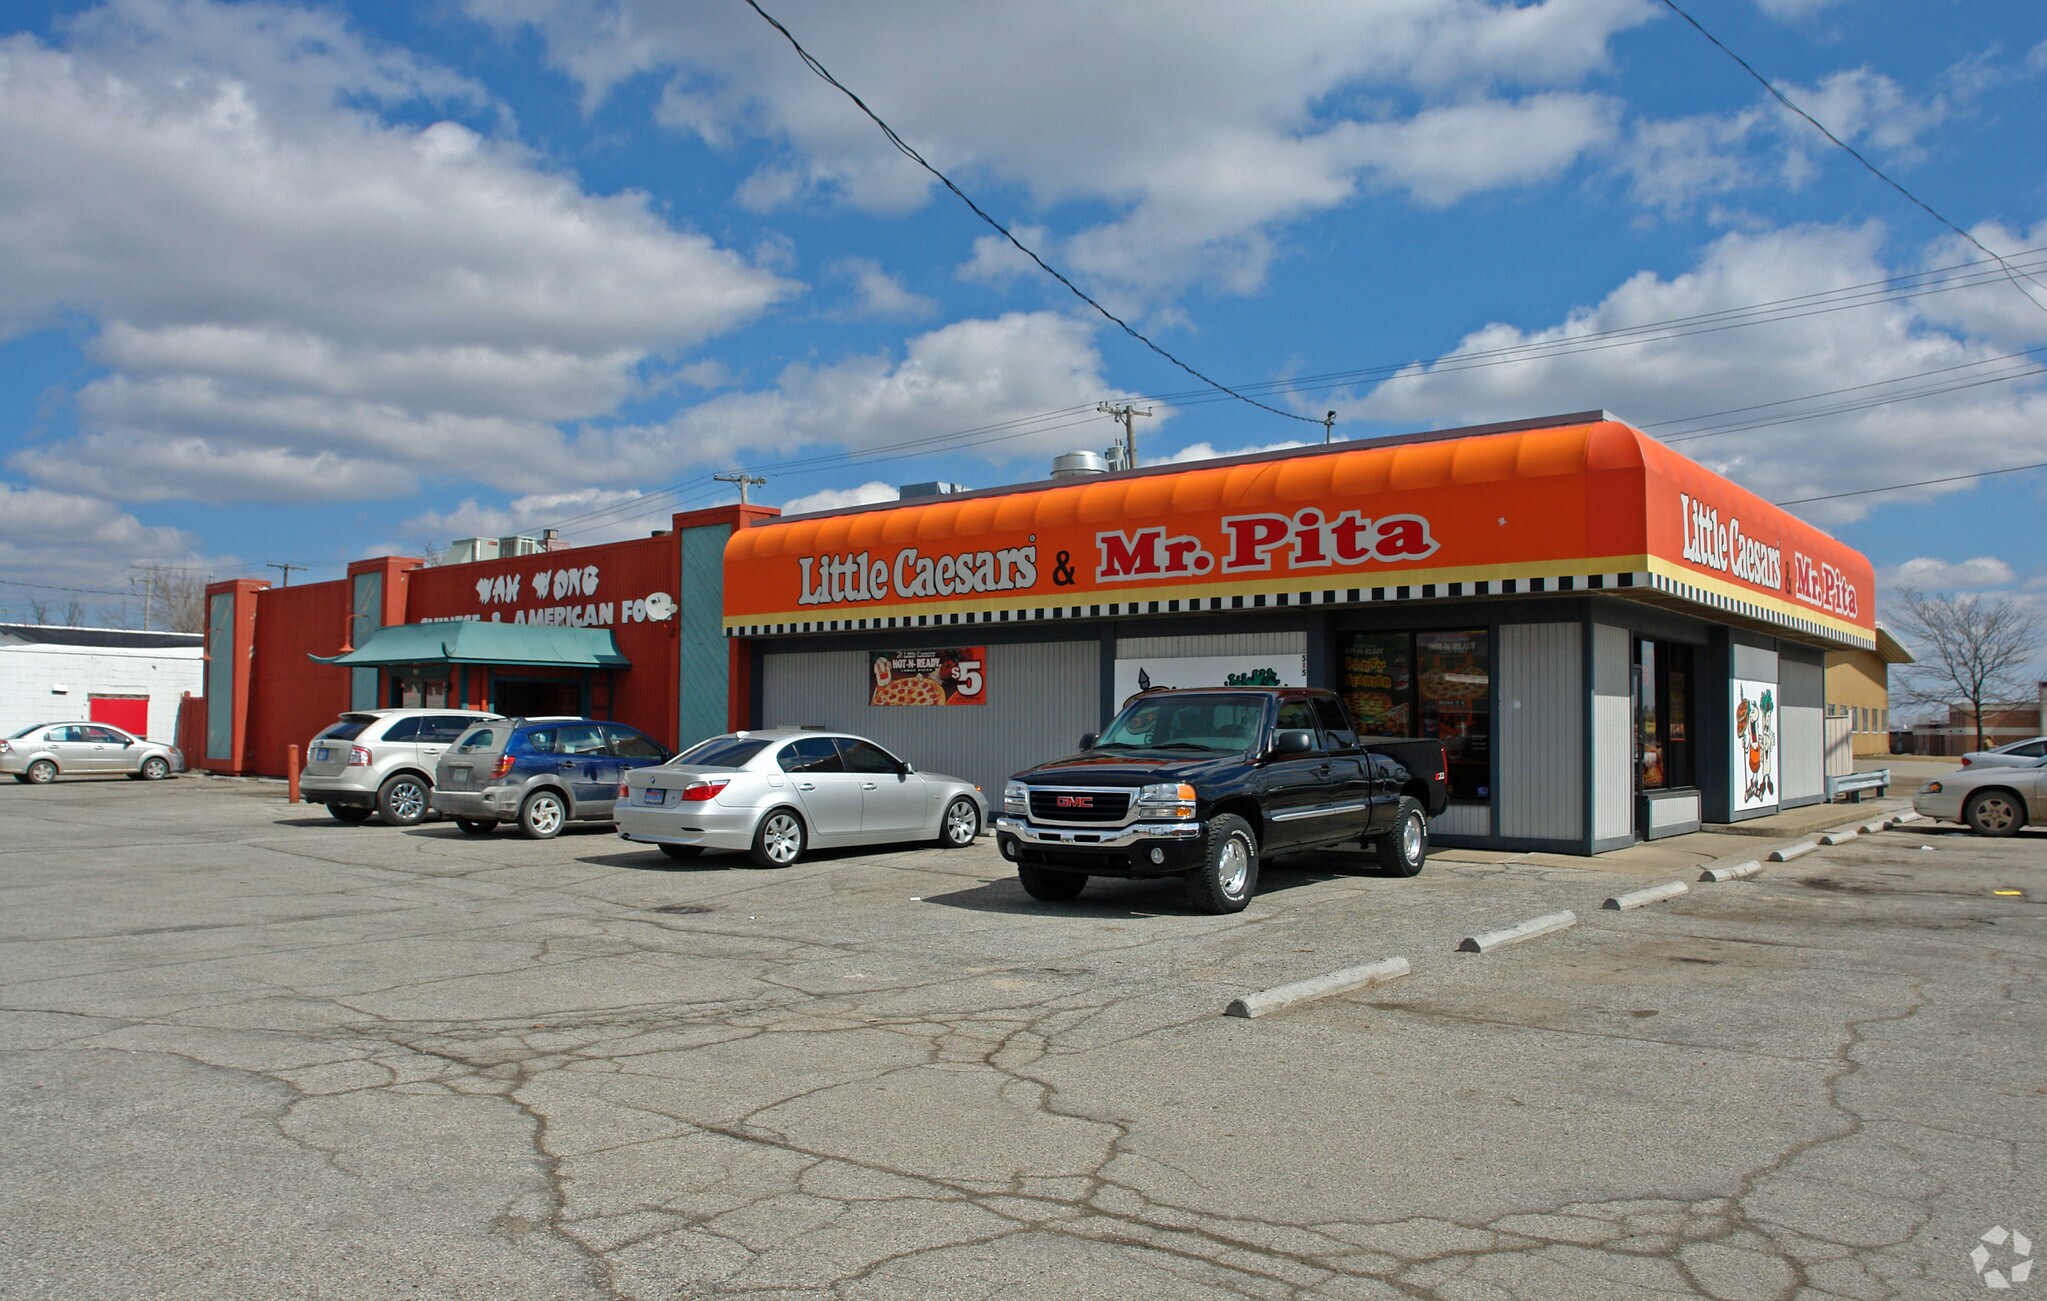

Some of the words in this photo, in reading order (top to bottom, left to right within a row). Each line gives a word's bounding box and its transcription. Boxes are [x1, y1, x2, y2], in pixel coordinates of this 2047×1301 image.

[798, 551, 889, 606] Little
[893, 547, 1038, 598] Caesars
[1052, 550, 1076, 587] &
[1096, 527, 1214, 582] Mr.
[1222, 507, 1439, 573] Pita
[1680, 491, 1728, 572] Little
[1729, 517, 1782, 591] Caesars
[1785, 561, 1792, 595] &
[1795, 551, 1822, 606] Mr.
[1822, 561, 1858, 619] Pita
[514, 602, 613, 628] AMERICAN
[951, 660, 983, 696] $5
[1056, 796, 1094, 808] GMC
